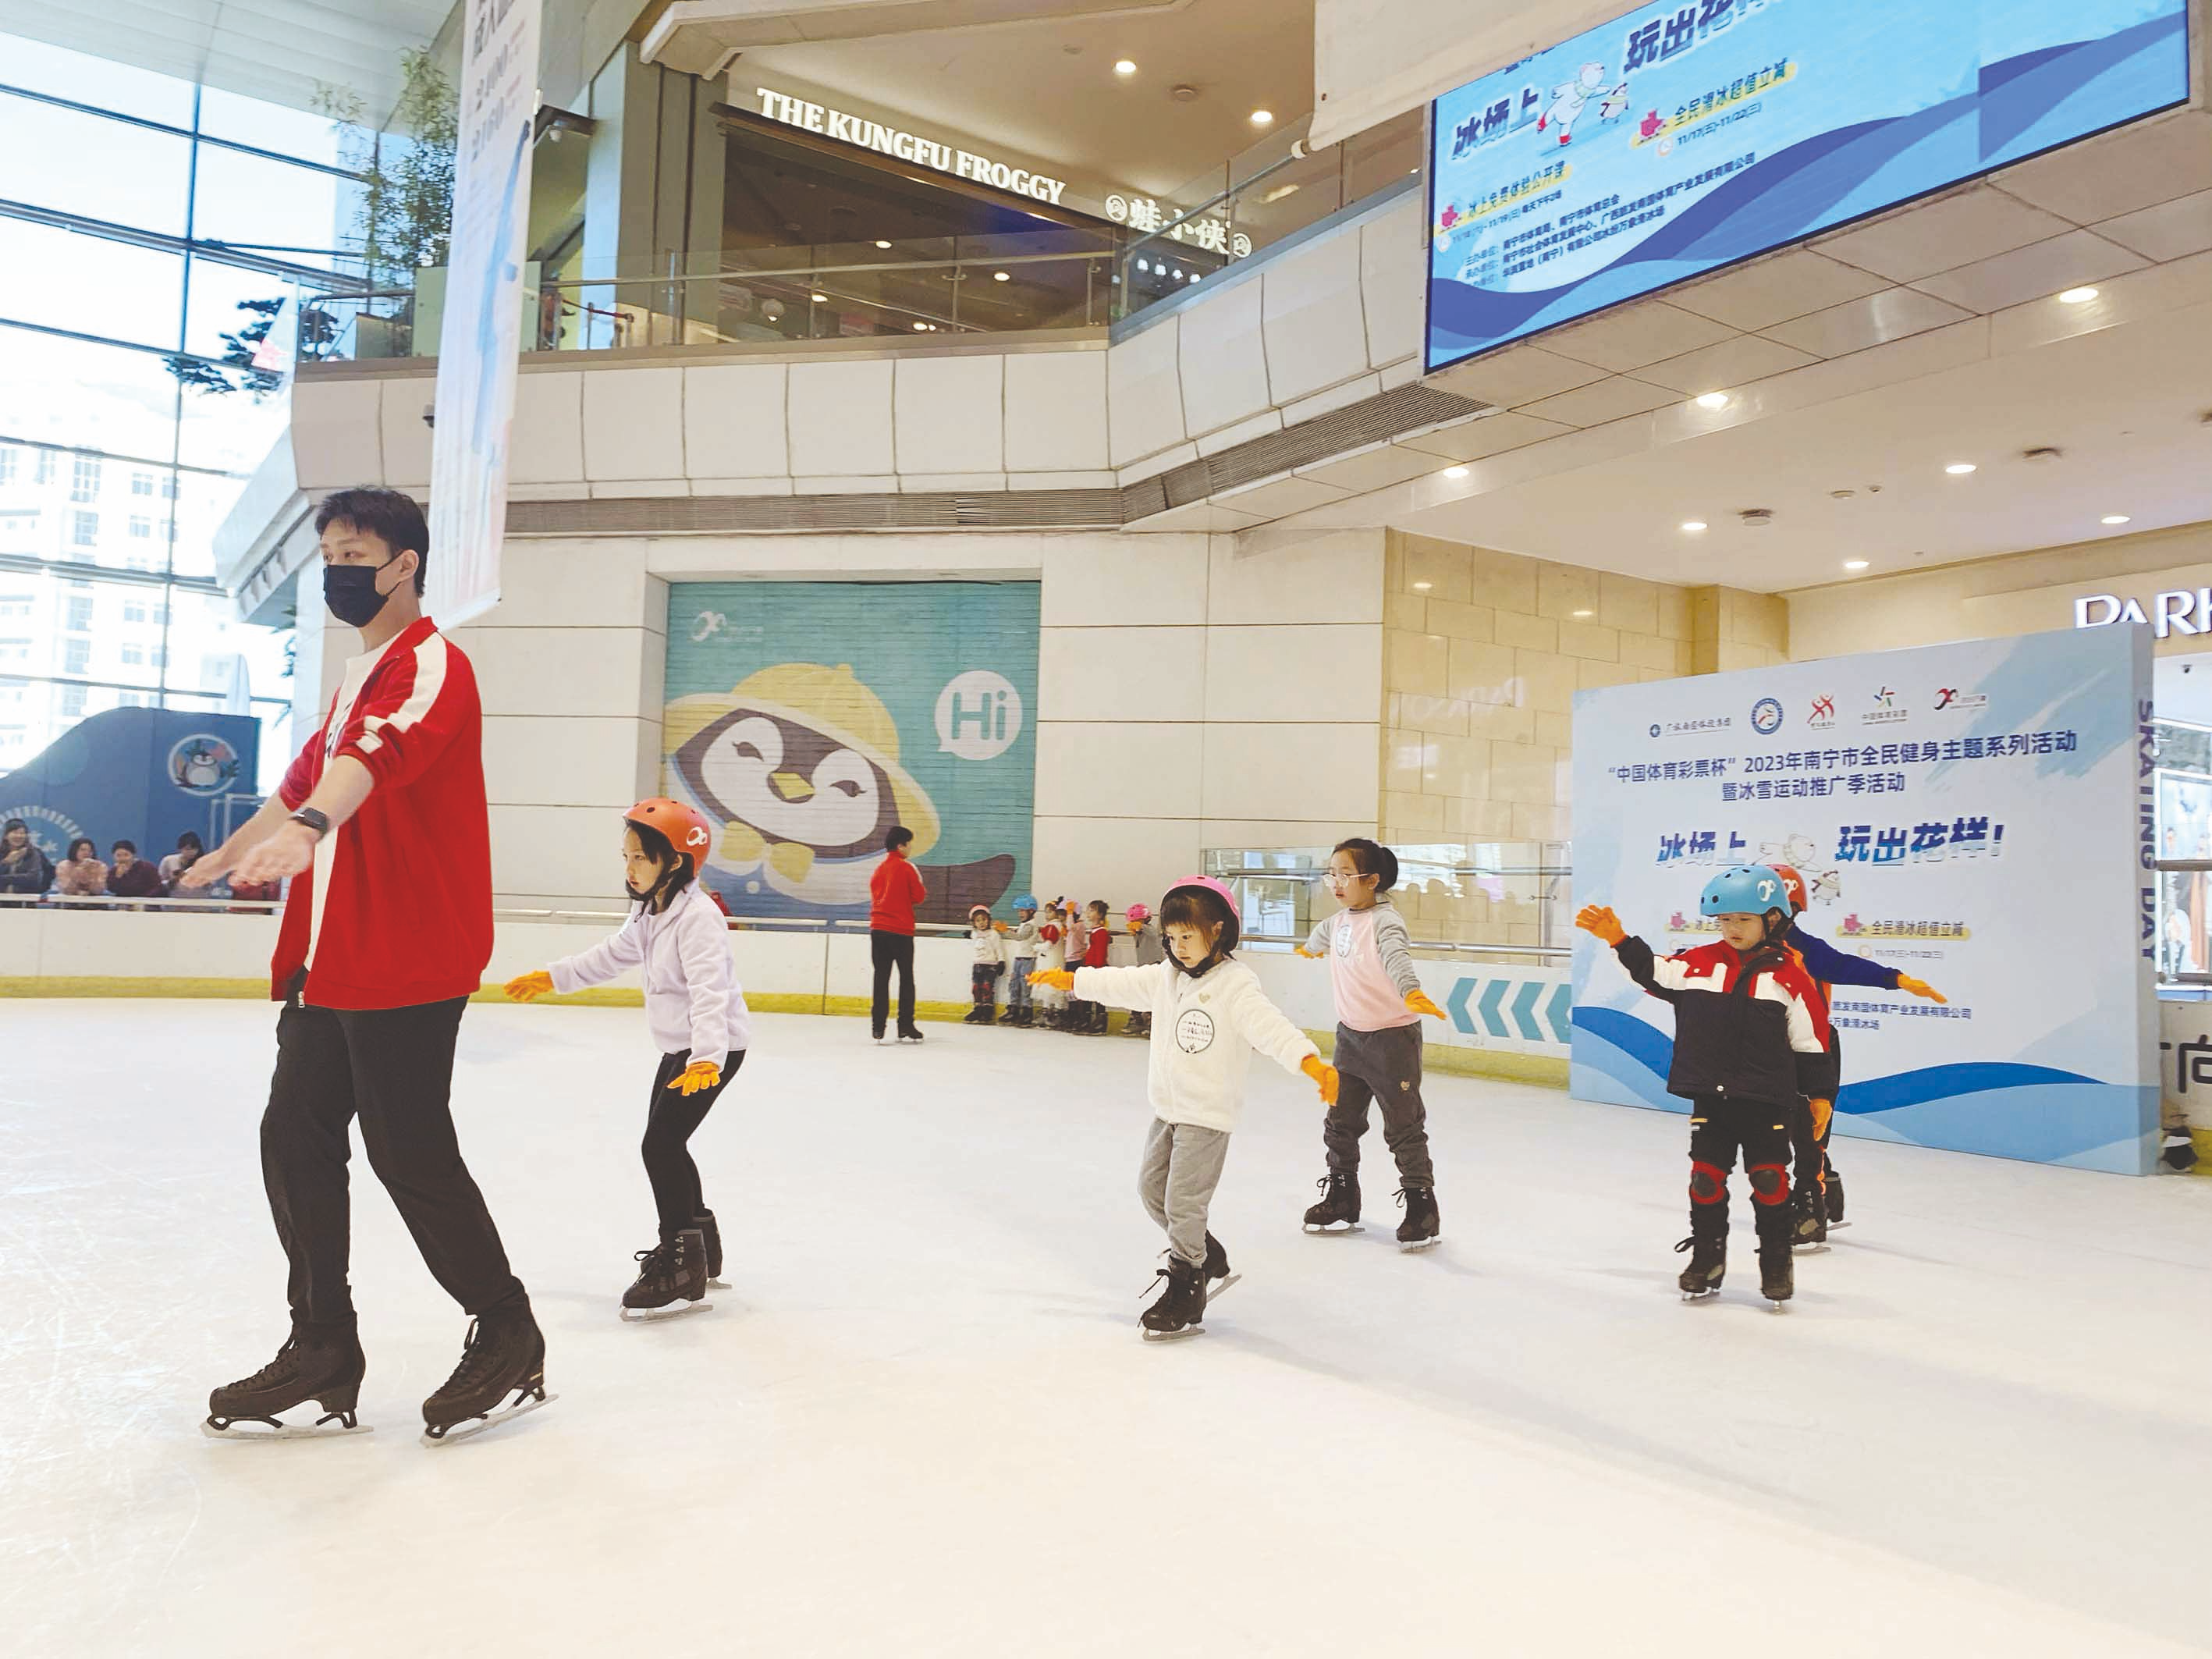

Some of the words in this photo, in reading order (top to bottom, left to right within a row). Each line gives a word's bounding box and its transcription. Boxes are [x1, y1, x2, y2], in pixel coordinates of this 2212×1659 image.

[1451, 88, 1538, 159] 冰场上
[1623, 0, 1766, 74] 玩出花
[756, 87, 824, 133] THE
[827, 108, 952, 172] KUNGFU
[955, 150, 1067, 205] FROGGY
[951, 690, 1008, 741] Hi
[1745, 730, 2077, 773] 2023年南宁市全民健身主题系列活动
[1722, 772, 1905, 801] 暨冰雪运动推广季活动
[1655, 830, 1746, 868] 冰场上
